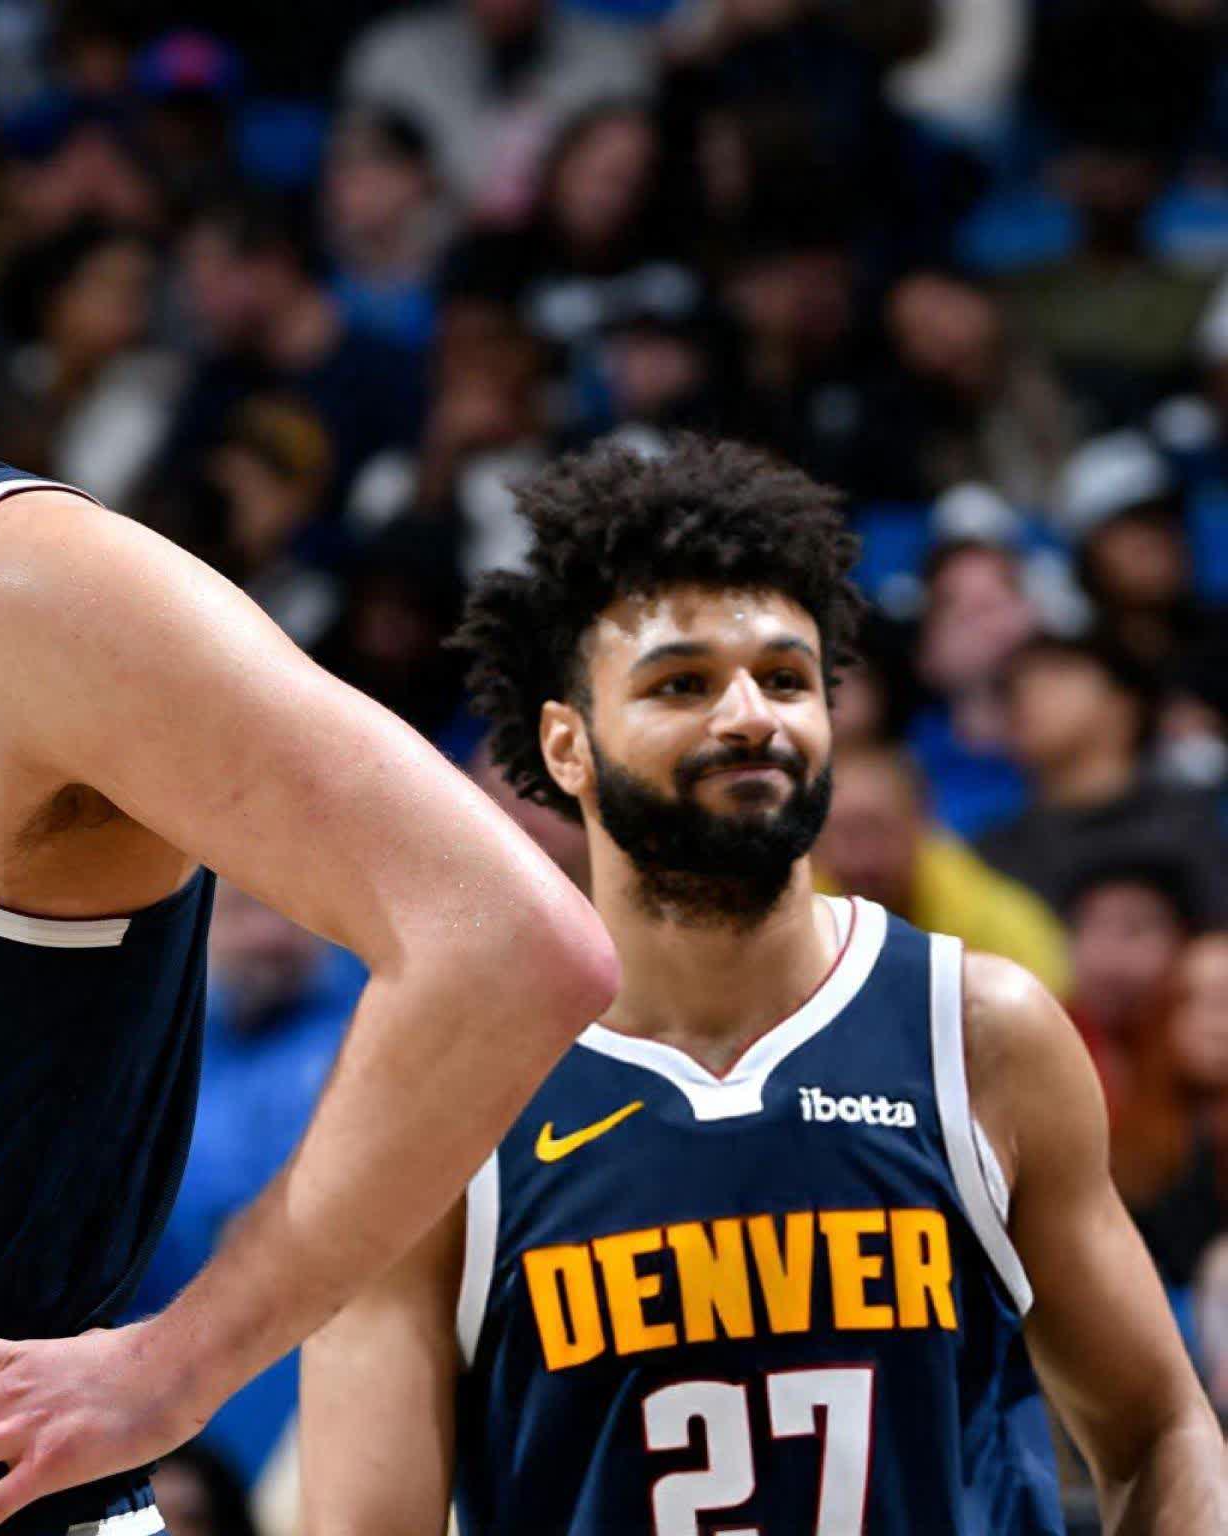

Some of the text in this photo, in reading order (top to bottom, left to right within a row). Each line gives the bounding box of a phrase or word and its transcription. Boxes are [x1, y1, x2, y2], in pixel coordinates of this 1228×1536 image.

[798, 1086, 917, 1128] ibotta
[522, 1207, 959, 1372] DENVER
[642, 1360, 875, 1536] 27
